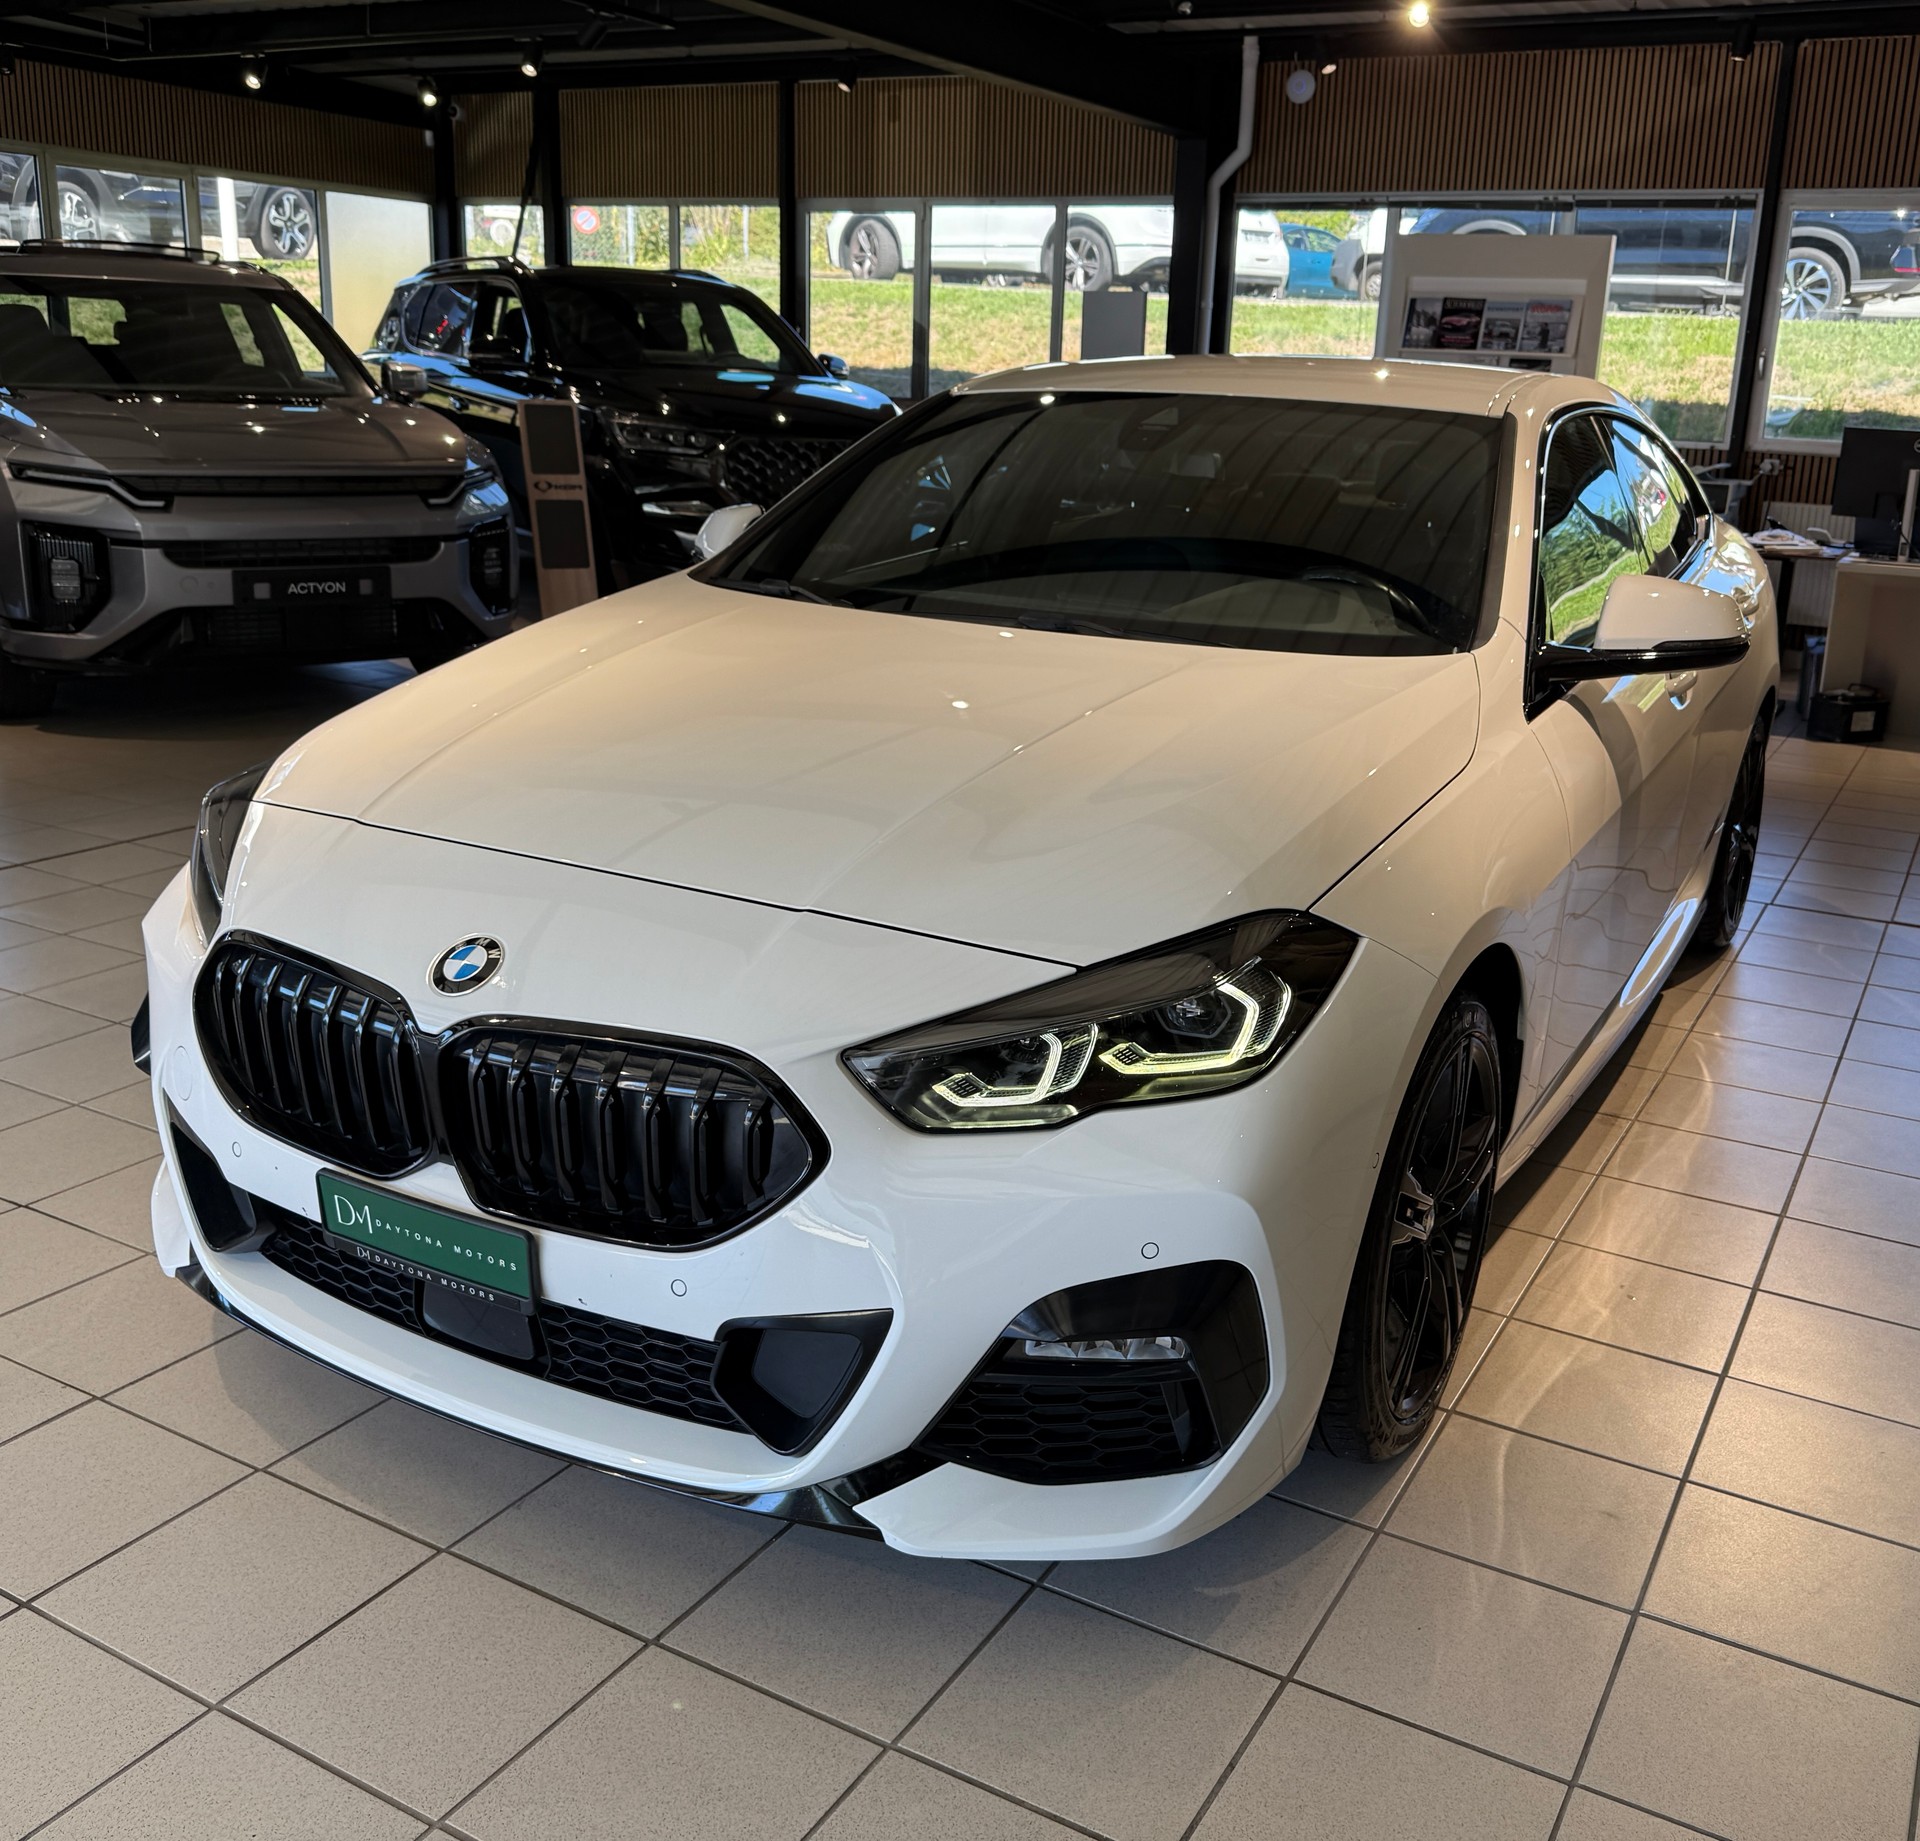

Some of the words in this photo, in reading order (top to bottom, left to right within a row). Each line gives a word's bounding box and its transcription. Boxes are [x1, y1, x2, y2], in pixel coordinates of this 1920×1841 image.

[287, 581, 346, 595] ACTYON
[375, 1219, 442, 1248] DAYTONA
[453, 1245, 517, 1271] MOTORS
[375, 1255, 432, 1281] DAYTONA
[440, 1278, 495, 1301] MOTORS
